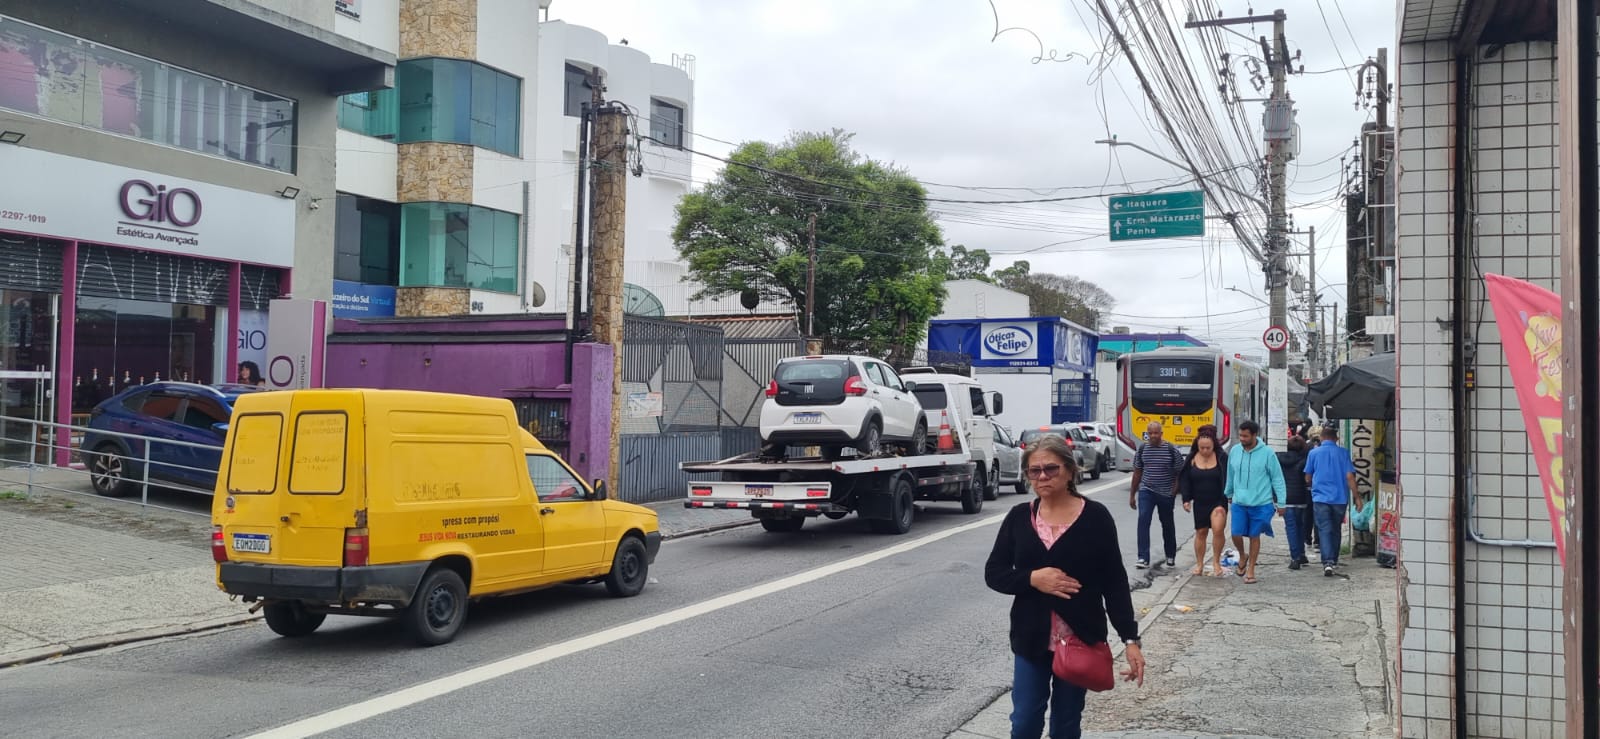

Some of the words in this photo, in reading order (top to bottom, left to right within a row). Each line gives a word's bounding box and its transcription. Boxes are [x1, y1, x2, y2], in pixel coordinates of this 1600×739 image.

[1127, 199, 1167, 209] Itaquera
[1150, 214, 1201, 223] Matarazzo
[117, 226, 154, 240] Estética
[156, 232, 198, 246] Avançada
[1127, 228, 1156, 236] Penha
[988, 331, 1016, 344] Óticas
[1266, 332, 1284, 343] 40
[997, 340, 1028, 351] Felipe
[1159, 367, 1188, 377] 3301-10
[464, 515, 477, 524] com
[457, 529, 499, 540] RESTAURANDO
[499, 528, 516, 536] VIDAS
